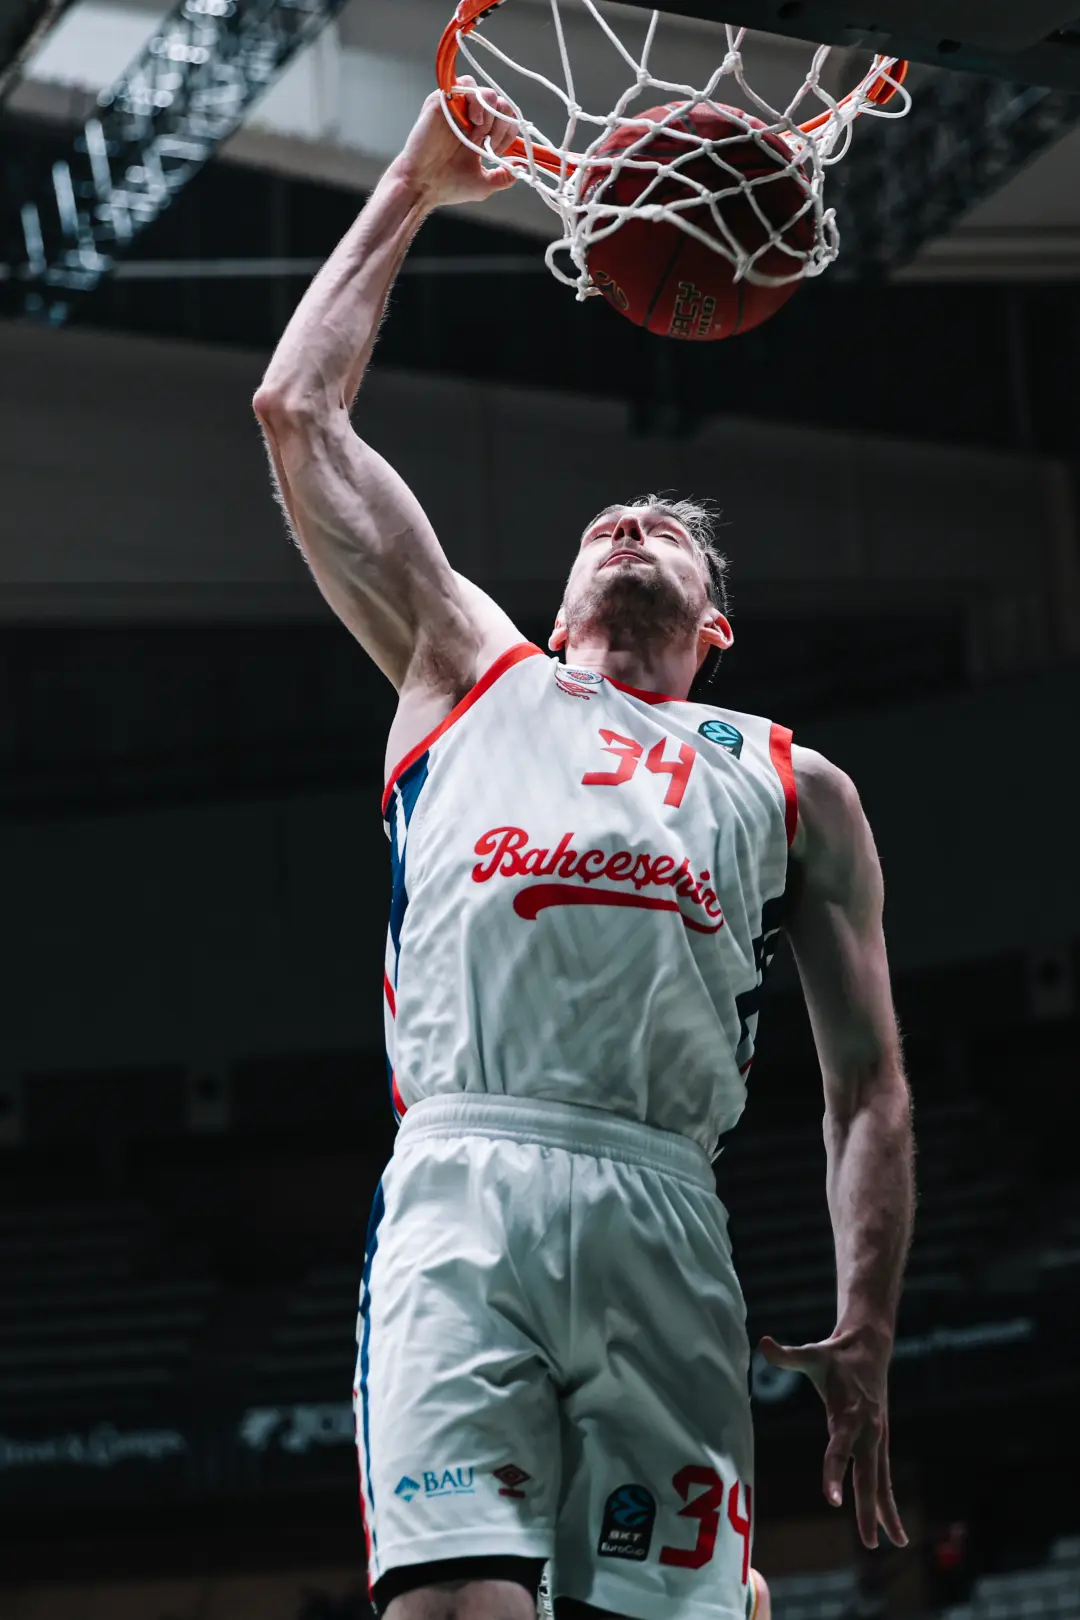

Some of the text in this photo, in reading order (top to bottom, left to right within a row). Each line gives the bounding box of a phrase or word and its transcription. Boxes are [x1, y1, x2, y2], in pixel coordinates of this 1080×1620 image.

[581, 728, 697, 808] 34
[422, 1466, 475, 1492] BAU
[659, 1464, 751, 1585] 34
